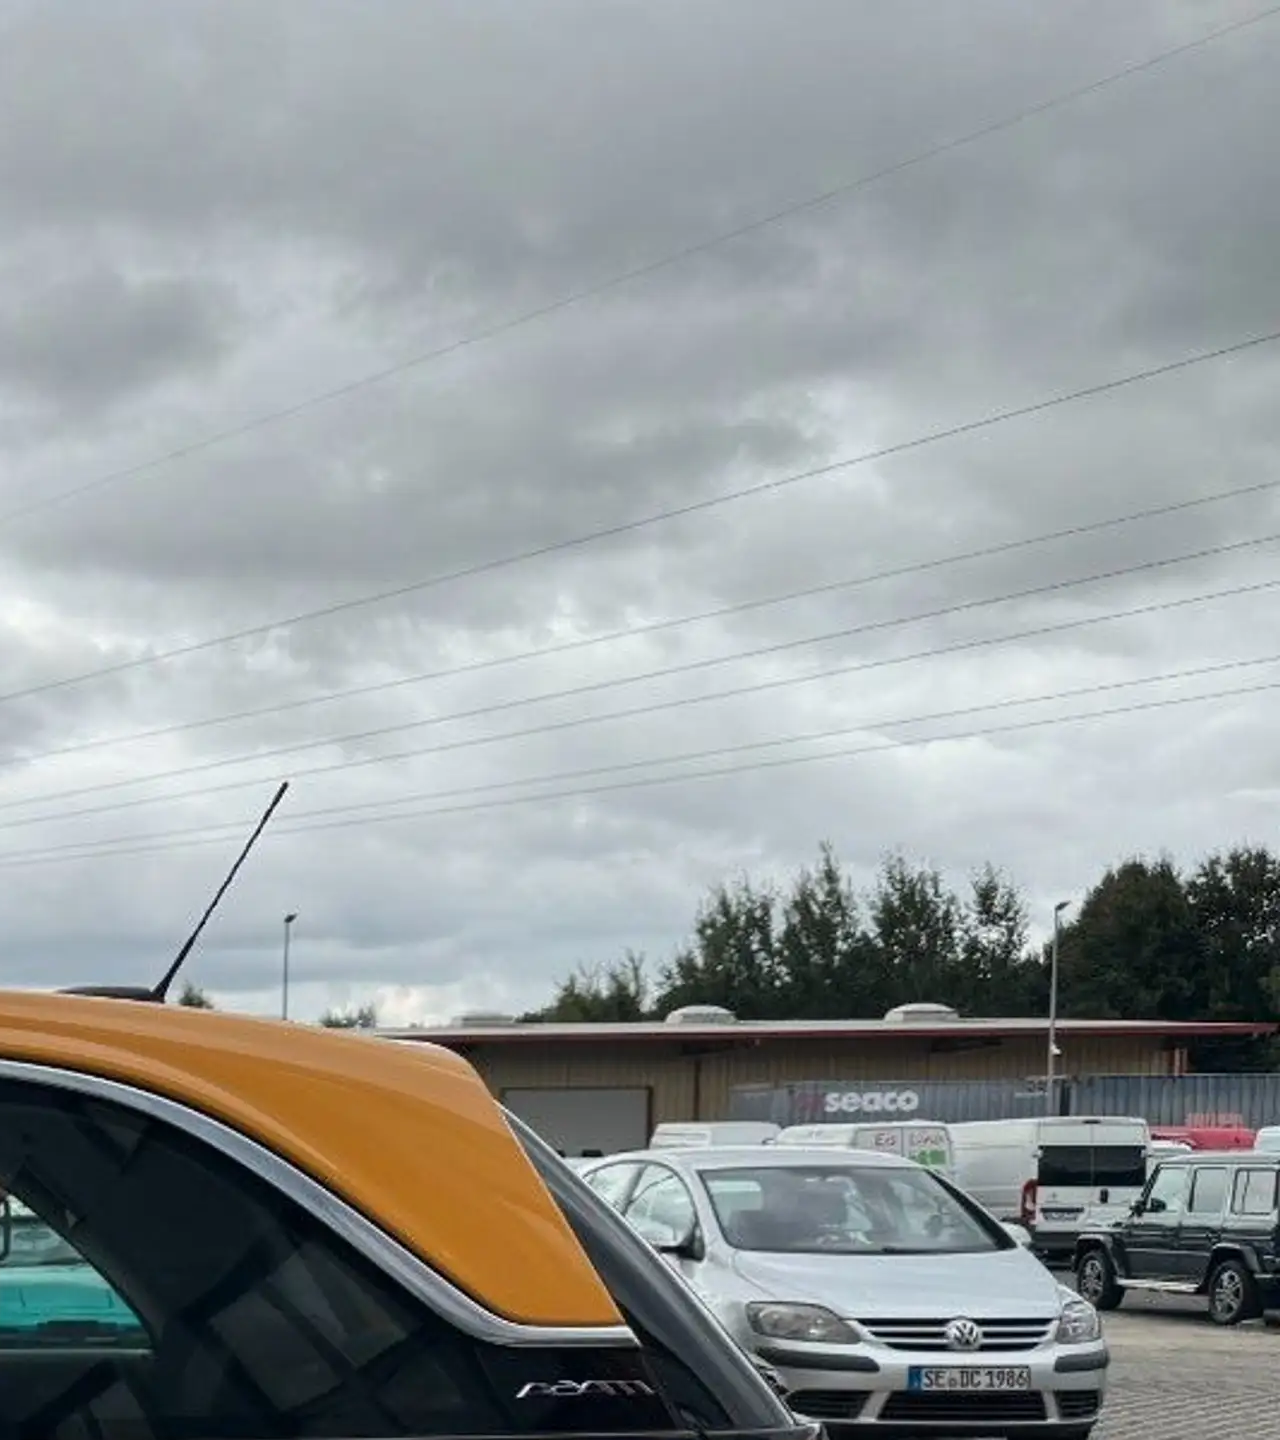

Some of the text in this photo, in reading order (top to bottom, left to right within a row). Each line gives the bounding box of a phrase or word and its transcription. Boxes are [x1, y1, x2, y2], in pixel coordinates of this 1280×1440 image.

[823, 1090, 919, 1113] seaco
[923, 1370, 1029, 1388] SE DC 1986
